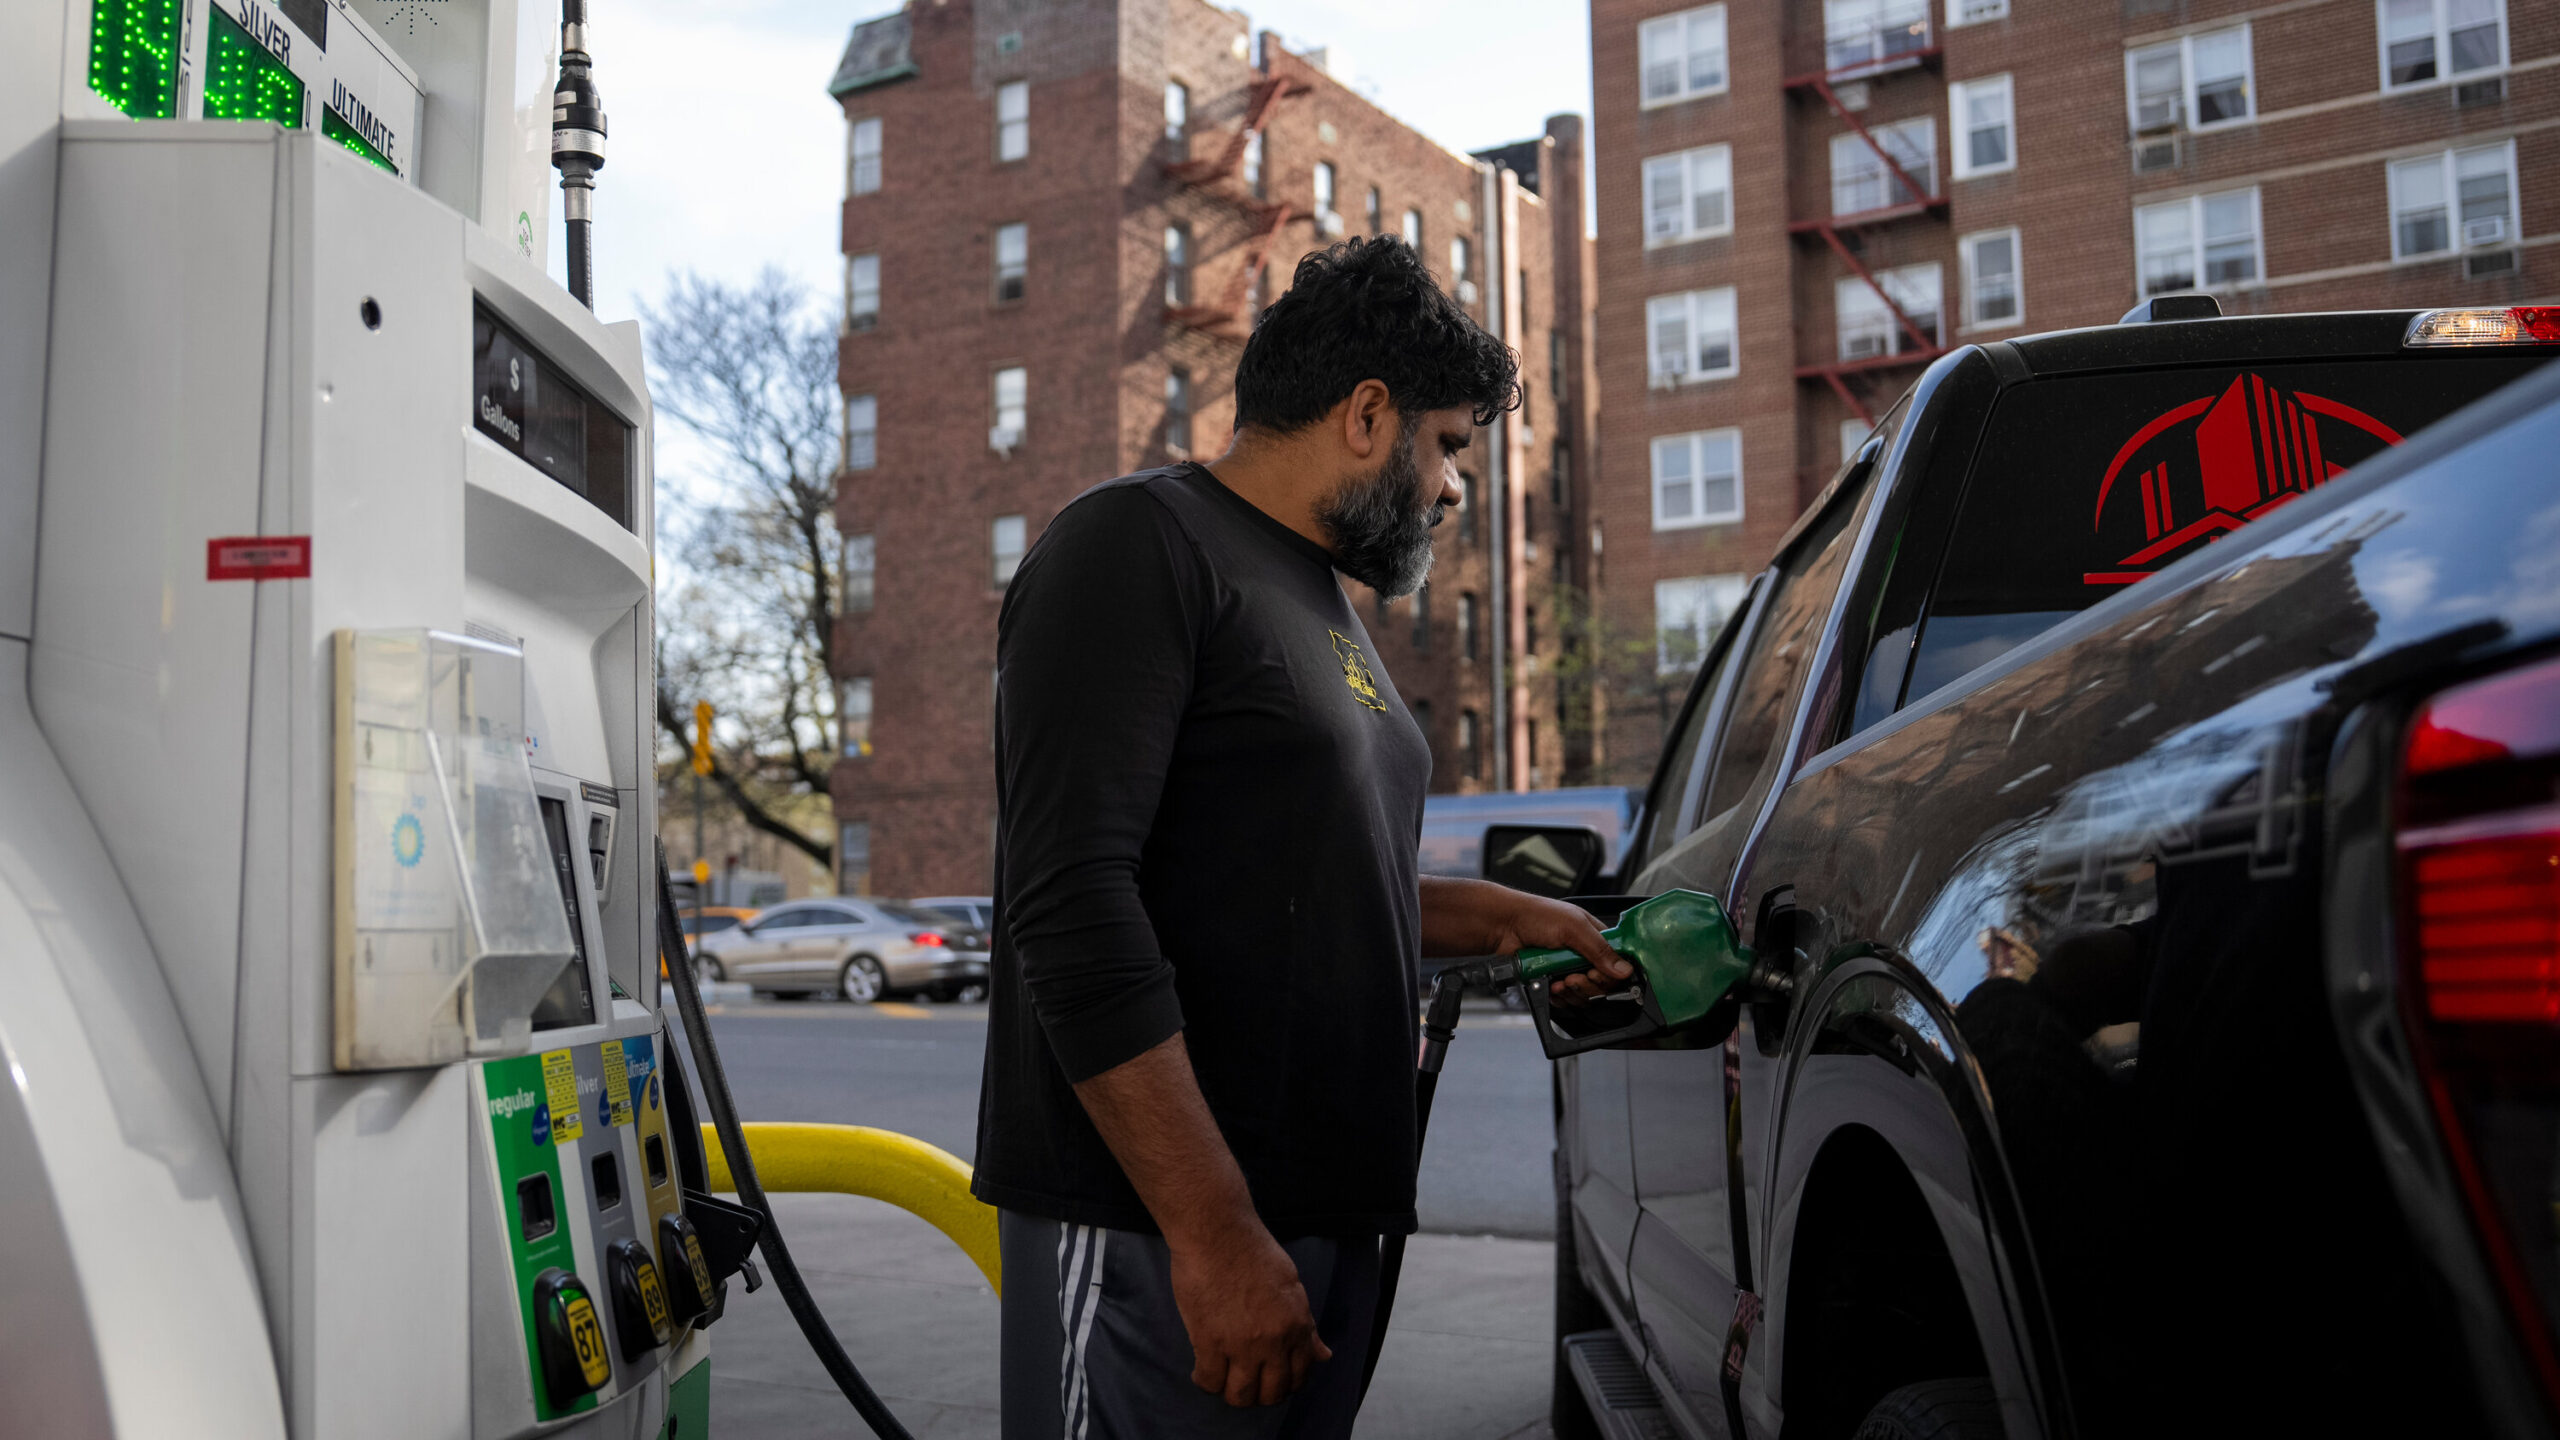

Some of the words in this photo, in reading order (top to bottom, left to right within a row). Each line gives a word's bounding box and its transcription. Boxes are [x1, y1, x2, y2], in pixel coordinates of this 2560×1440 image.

[240, 0, 291, 67] SILVER
[332, 77, 395, 162] ULTIMATE
[481, 394, 521, 443] Gallons
[626, 1056, 651, 1079] ultimate
[576, 1073, 600, 1096] ilver
[489, 1087, 536, 1119] regular
[692, 1254, 709, 1287] 93
[645, 1285, 663, 1318] 89
[576, 1319, 599, 1362] 87
